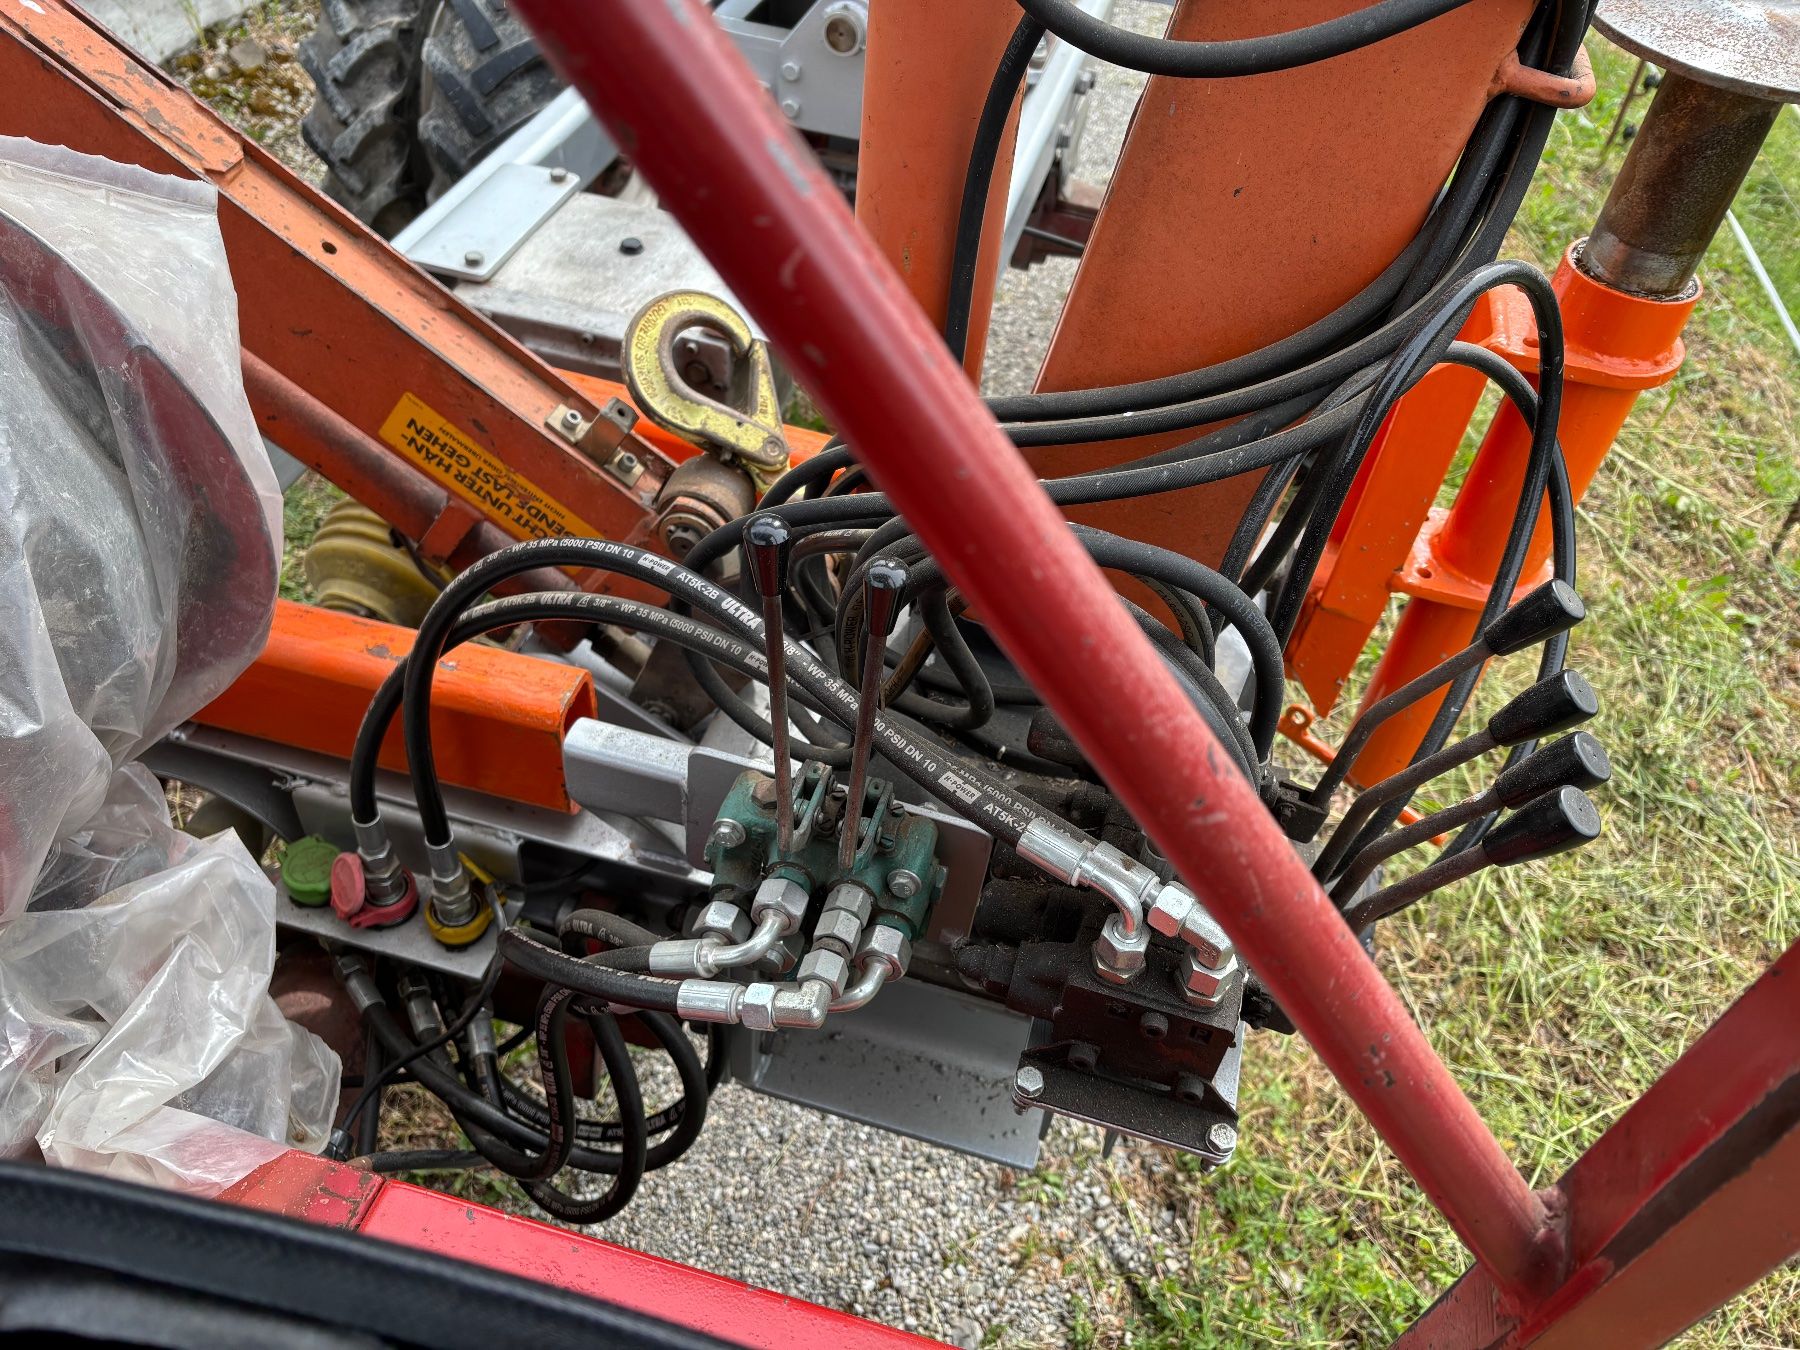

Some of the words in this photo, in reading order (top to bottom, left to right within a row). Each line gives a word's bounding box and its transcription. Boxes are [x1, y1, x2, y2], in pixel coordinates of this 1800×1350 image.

[401, 433, 453, 474] HÄN-
[406, 417, 471, 469] GEHEN
[454, 469, 513, 517] UNTER
[471, 466, 515, 500] LAST
[511, 513, 549, 538] CHT
[540, 593, 573, 606] ULTRA
[620, 603, 637, 614] WP
[637, 607, 648, 618] 35
[649, 610, 668, 625] MPa
[669, 618, 694, 634] (5000
[694, 625, 713, 643] PSI)
[713, 633, 729, 649] DN
[730, 641, 742, 656] 10
[527, 540, 538, 549] 35
[539, 538, 558, 547] MPa
[560, 538, 585, 548] (5000
[586, 540, 604, 551] PSI)
[605, 544, 622, 555] DN
[623, 549, 635, 559] 10
[676, 571, 720, 600] AT5K-2B
[720, 597, 763, 631] ULTRA
[807, 663, 827, 680] WP
[824, 678, 840, 692] 35
[836, 688, 859, 711] MPa
[884, 728, 907, 749] PSI)
[904, 744, 924, 762] DN
[923, 759, 937, 772] 10
[982, 802, 1027, 833] AT5K-2
